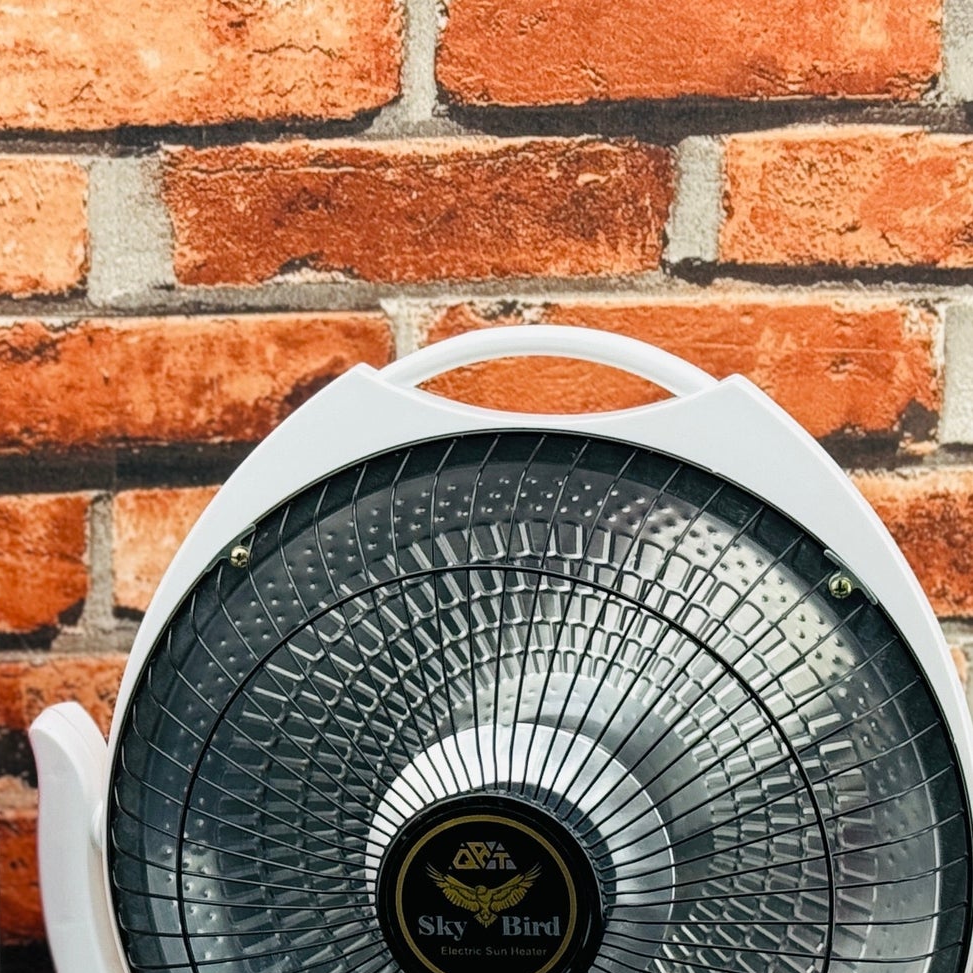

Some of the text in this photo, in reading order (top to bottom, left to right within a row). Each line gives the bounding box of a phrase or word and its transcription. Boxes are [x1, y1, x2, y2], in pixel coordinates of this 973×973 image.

[418, 915, 561, 941] Sky Bird
[440, 946, 548, 956] Electric Sun Heater
